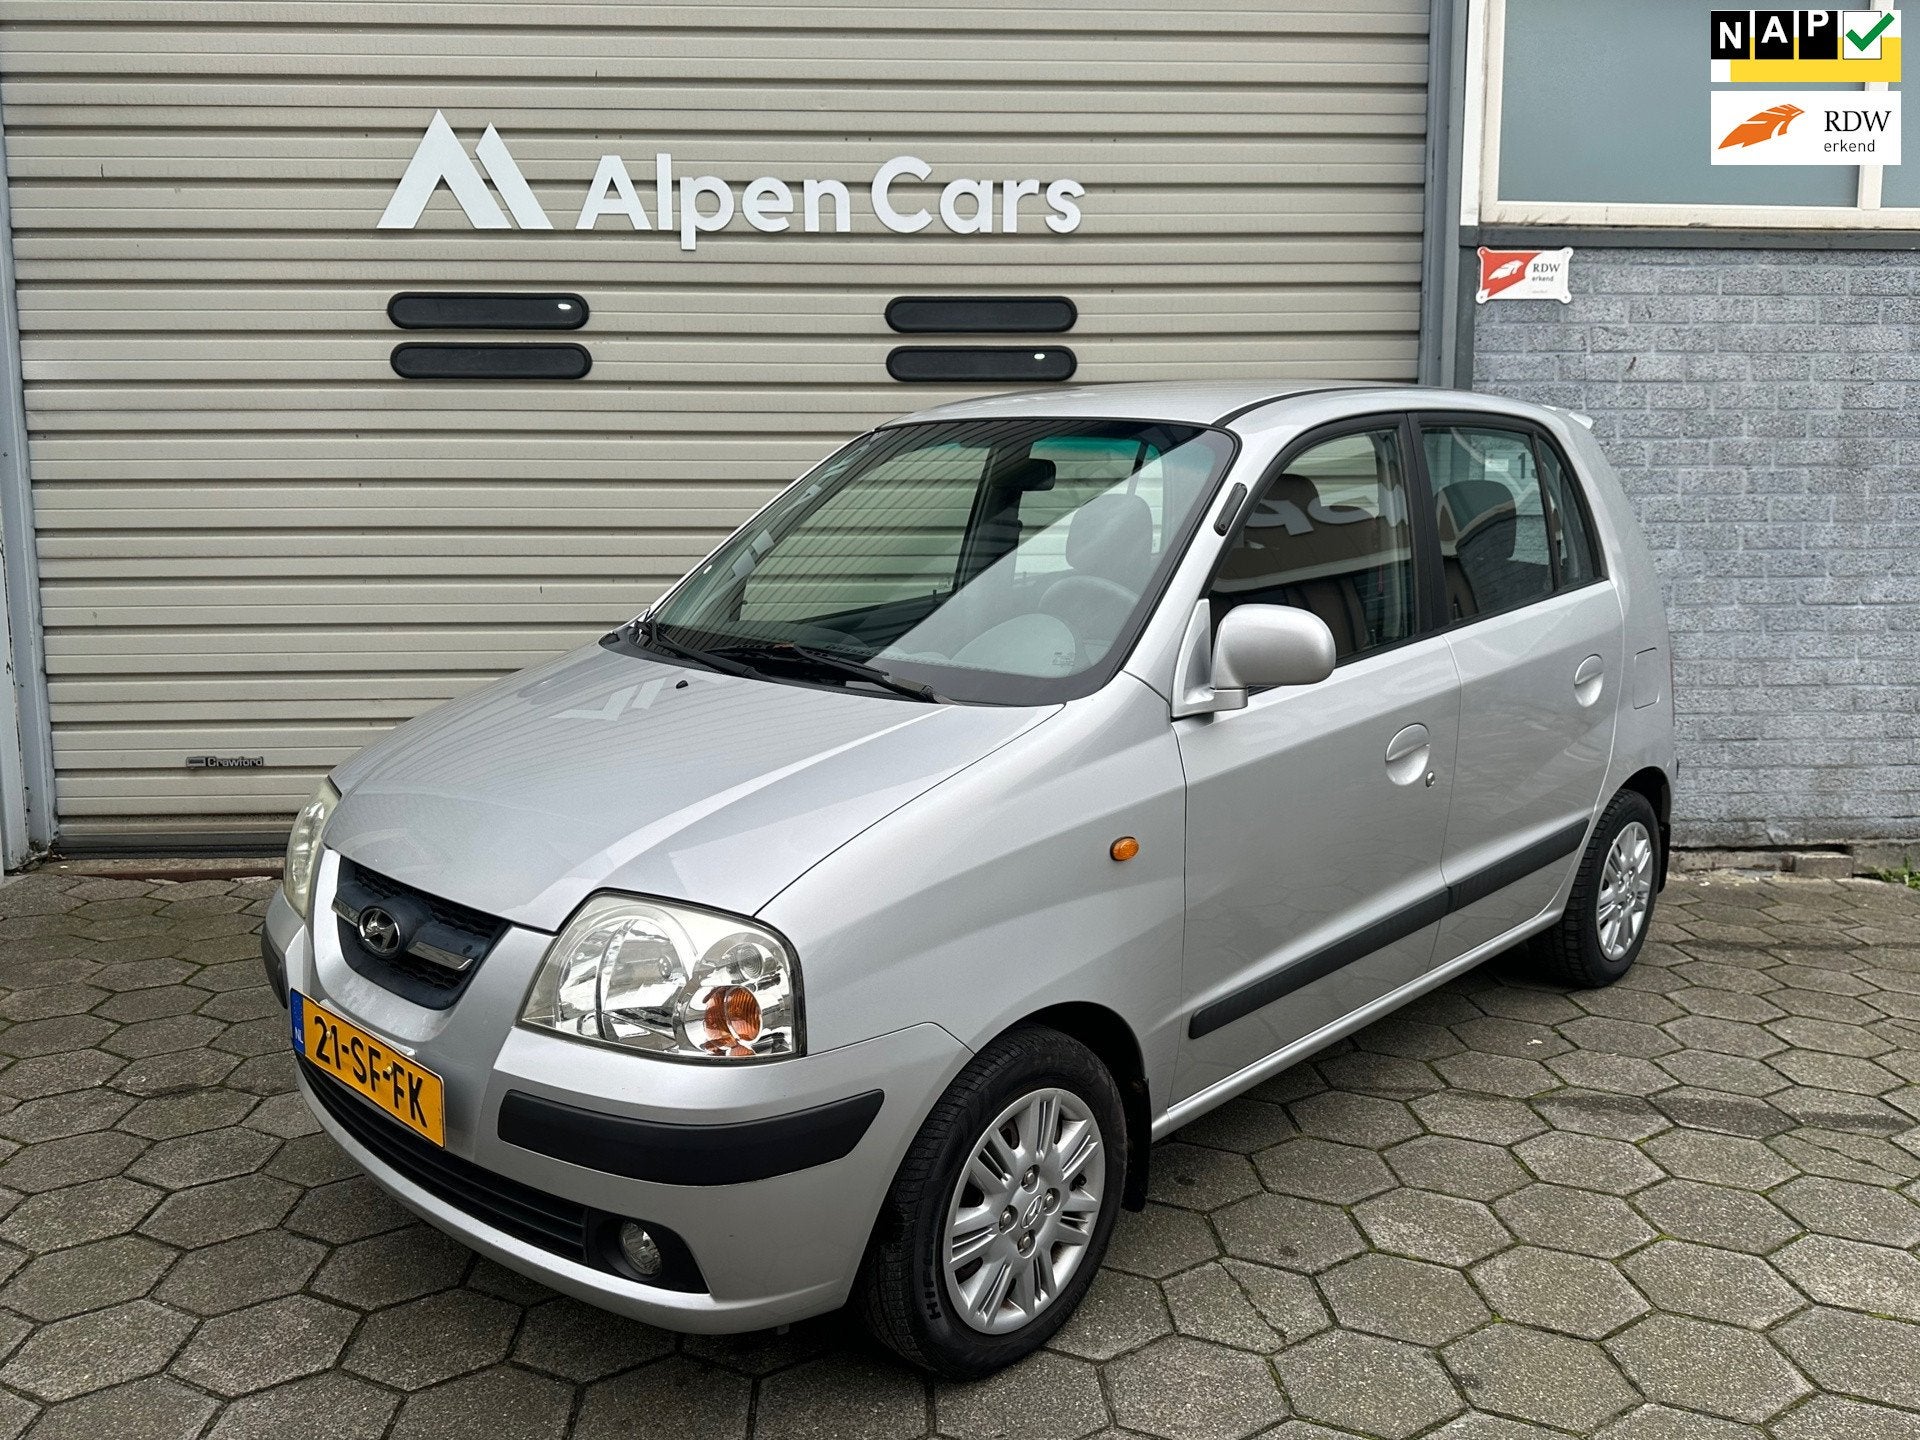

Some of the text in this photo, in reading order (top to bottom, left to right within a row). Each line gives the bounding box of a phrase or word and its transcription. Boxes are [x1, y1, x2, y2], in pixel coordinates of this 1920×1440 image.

[575, 152, 1086, 250] Alpen Cars
[1532, 263, 1560, 273] RDW
[207, 756, 263, 767] Crawford
[294, 1026, 304, 1044] NL
[314, 1016, 428, 1129] 21-SF-FK
